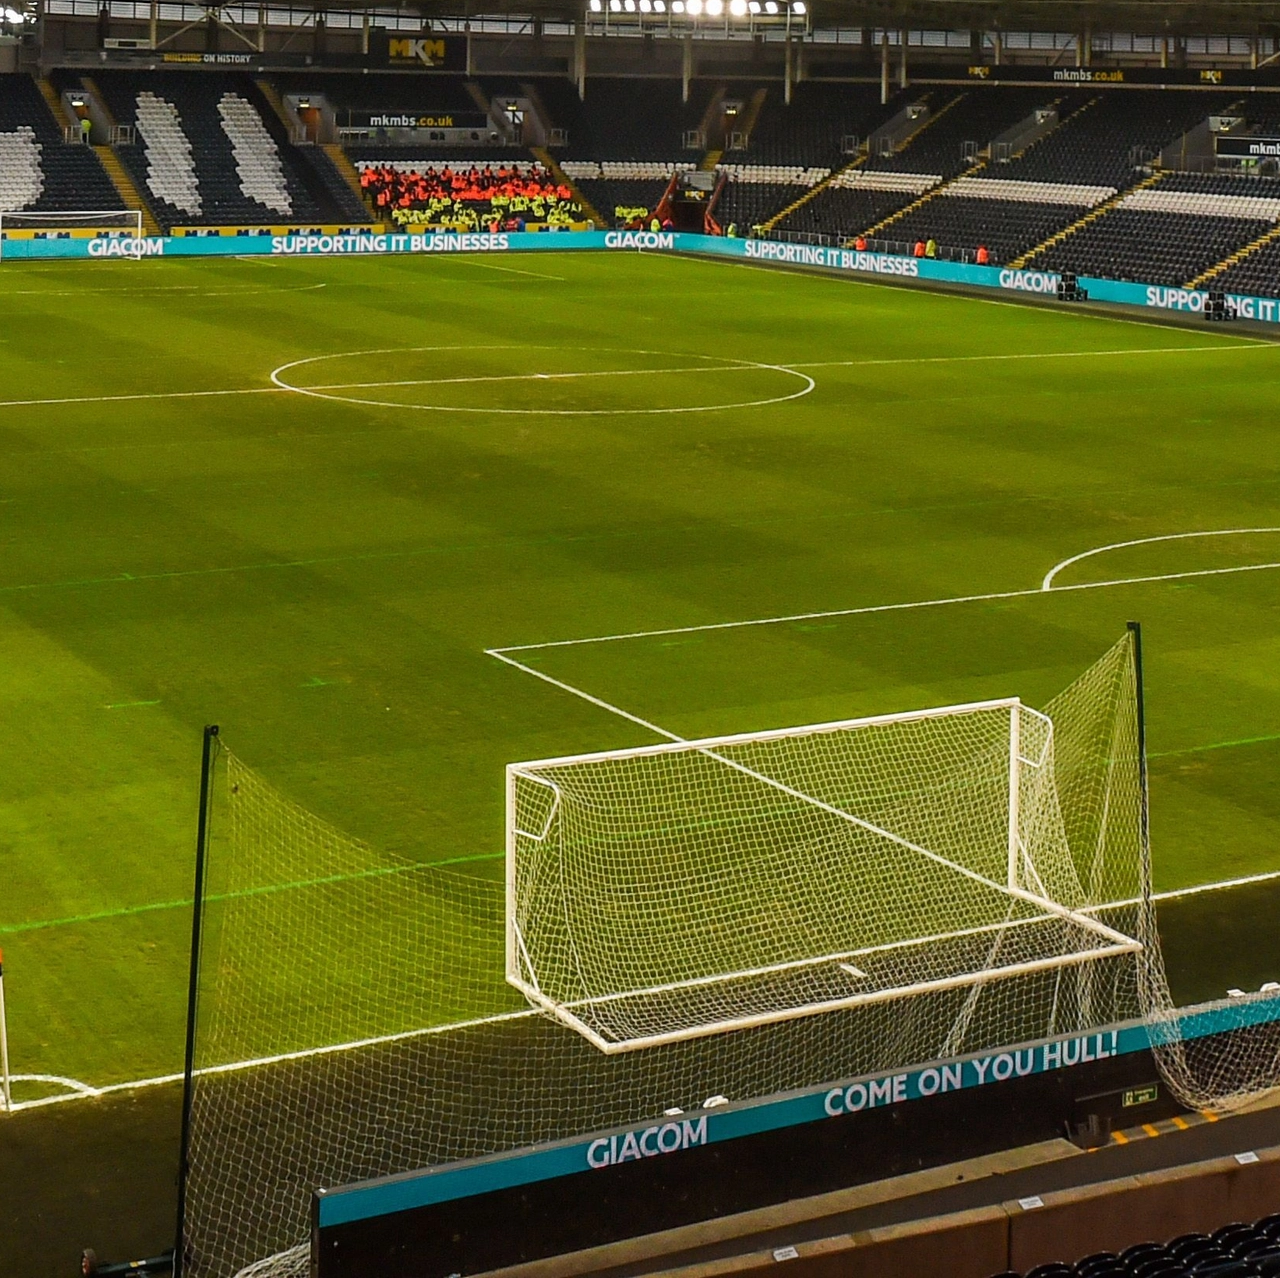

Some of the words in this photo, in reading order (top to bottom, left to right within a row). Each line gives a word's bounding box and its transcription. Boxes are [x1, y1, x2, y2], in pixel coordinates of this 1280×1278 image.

[203, 54, 215, 63] ON
[217, 54, 251, 64] HISTORY
[389, 39, 445, 66] MKM
[1053, 69, 1124, 83] mkmbs.co.uk
[370, 114, 454, 127] mkmbs.co.uk
[271, 235, 387, 254] SUPPORTING
[391, 235, 408, 252] IT
[410, 234, 508, 251] BUSINESSES
[744, 239, 824, 265] SUPPORTING
[827, 249, 840, 267] IT
[842, 251, 918, 277] BUSINESSES
[999, 269, 1058, 293] GIACOM
[1258, 299, 1275, 321] IT
[824, 1070, 907, 1119] COME
[916, 1063, 963, 1098] ON
[972, 1048, 1036, 1084] YOU
[1042, 1030, 1120, 1070] HULL!
[586, 1115, 708, 1169] GIACOM
